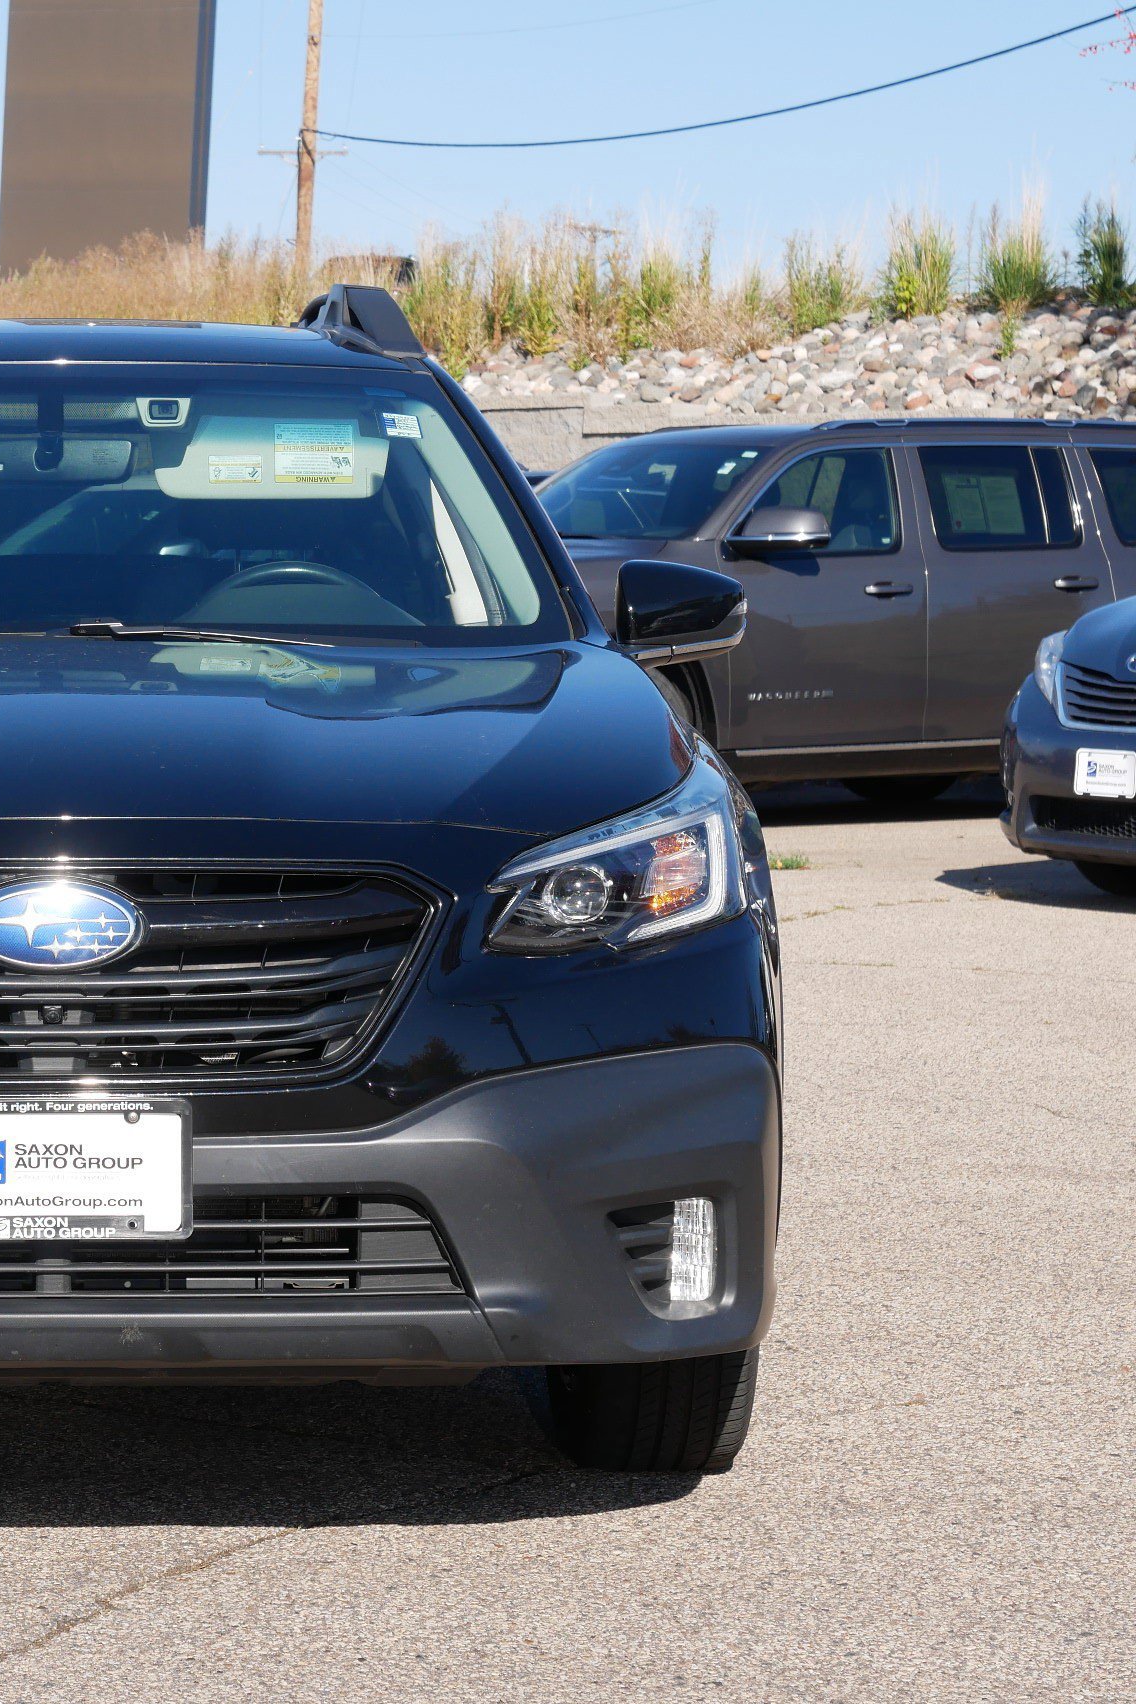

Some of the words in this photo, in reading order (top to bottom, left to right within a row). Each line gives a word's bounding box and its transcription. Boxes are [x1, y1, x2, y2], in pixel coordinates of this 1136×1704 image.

[0, 1102, 8, 1111] it
[11, 1102, 43, 1113] right.
[46, 1102, 75, 1111] Four
[77, 1101, 154, 1112] generations.
[15, 1144, 83, 1156] SAXON
[14, 1157, 68, 1169] AUTO
[72, 1157, 144, 1169] GROUP
[12, 1217, 69, 1227] SAXON
[12, 1227, 56, 1238] AUTO
[58, 1227, 117, 1238] GROUP
